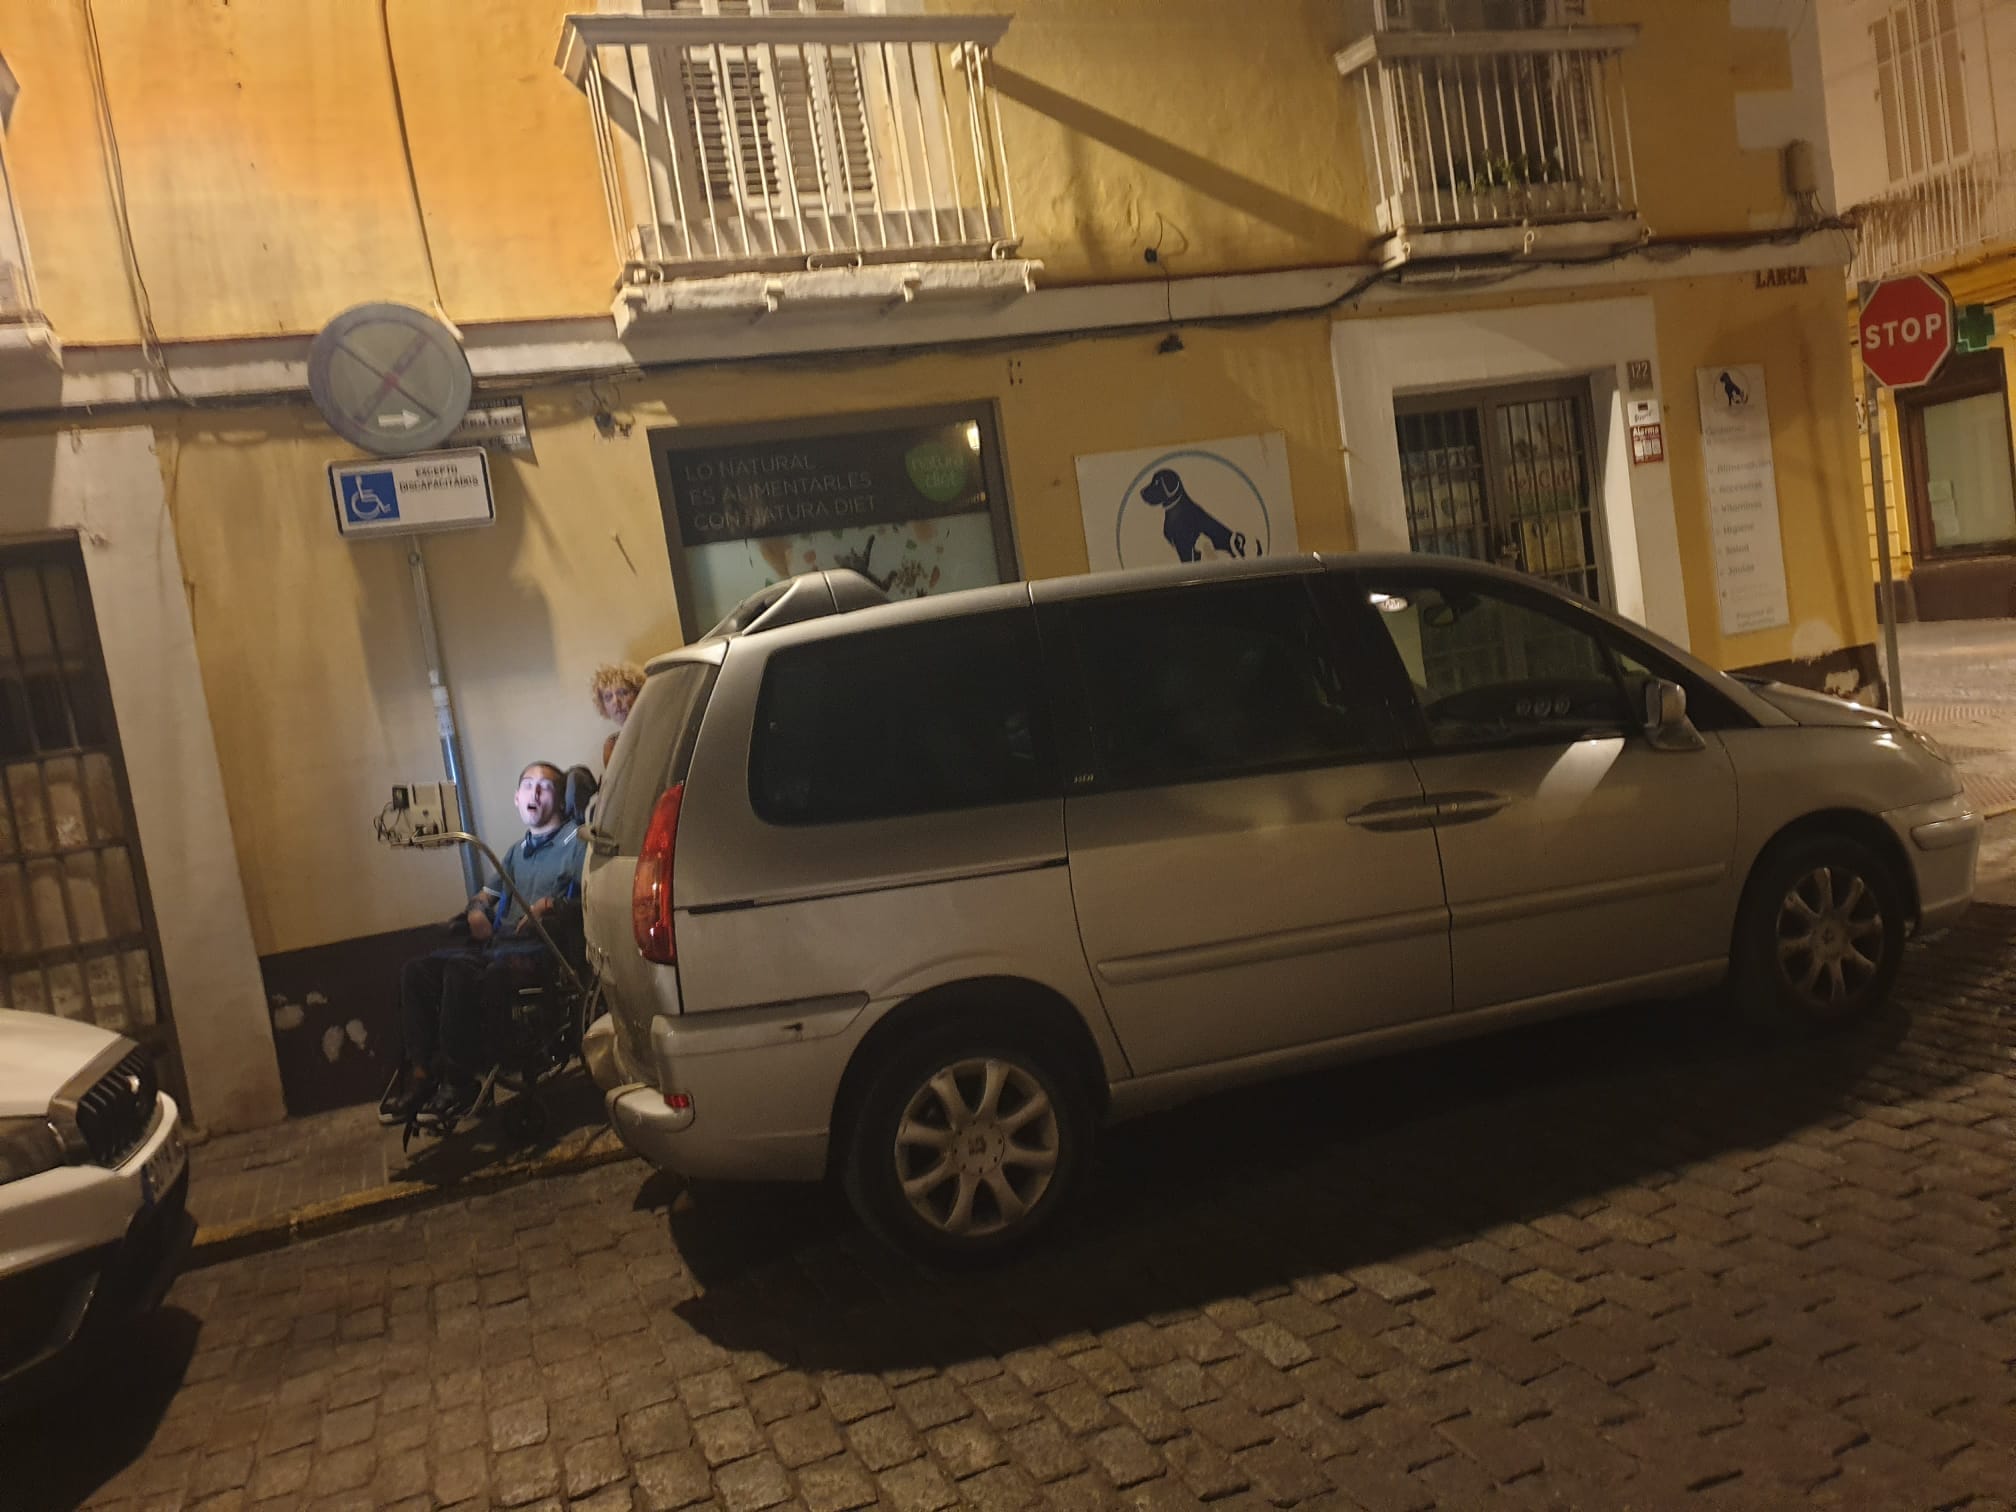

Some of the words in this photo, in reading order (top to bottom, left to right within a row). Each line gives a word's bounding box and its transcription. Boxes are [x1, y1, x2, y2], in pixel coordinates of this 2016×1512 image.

[1865, 313, 1942, 349] STOP
[415, 465, 457, 477] EXCEPTO
[685, 464, 712, 481] LO
[719, 453, 816, 479] NATURAL
[400, 475, 479, 493] DISCAPACITADOS
[690, 488, 716, 506] ES
[722, 471, 872, 503] ALIMENTARLES
[694, 511, 740, 530] CON
[744, 501, 829, 527] NATURA
[835, 494, 876, 514] DIET
